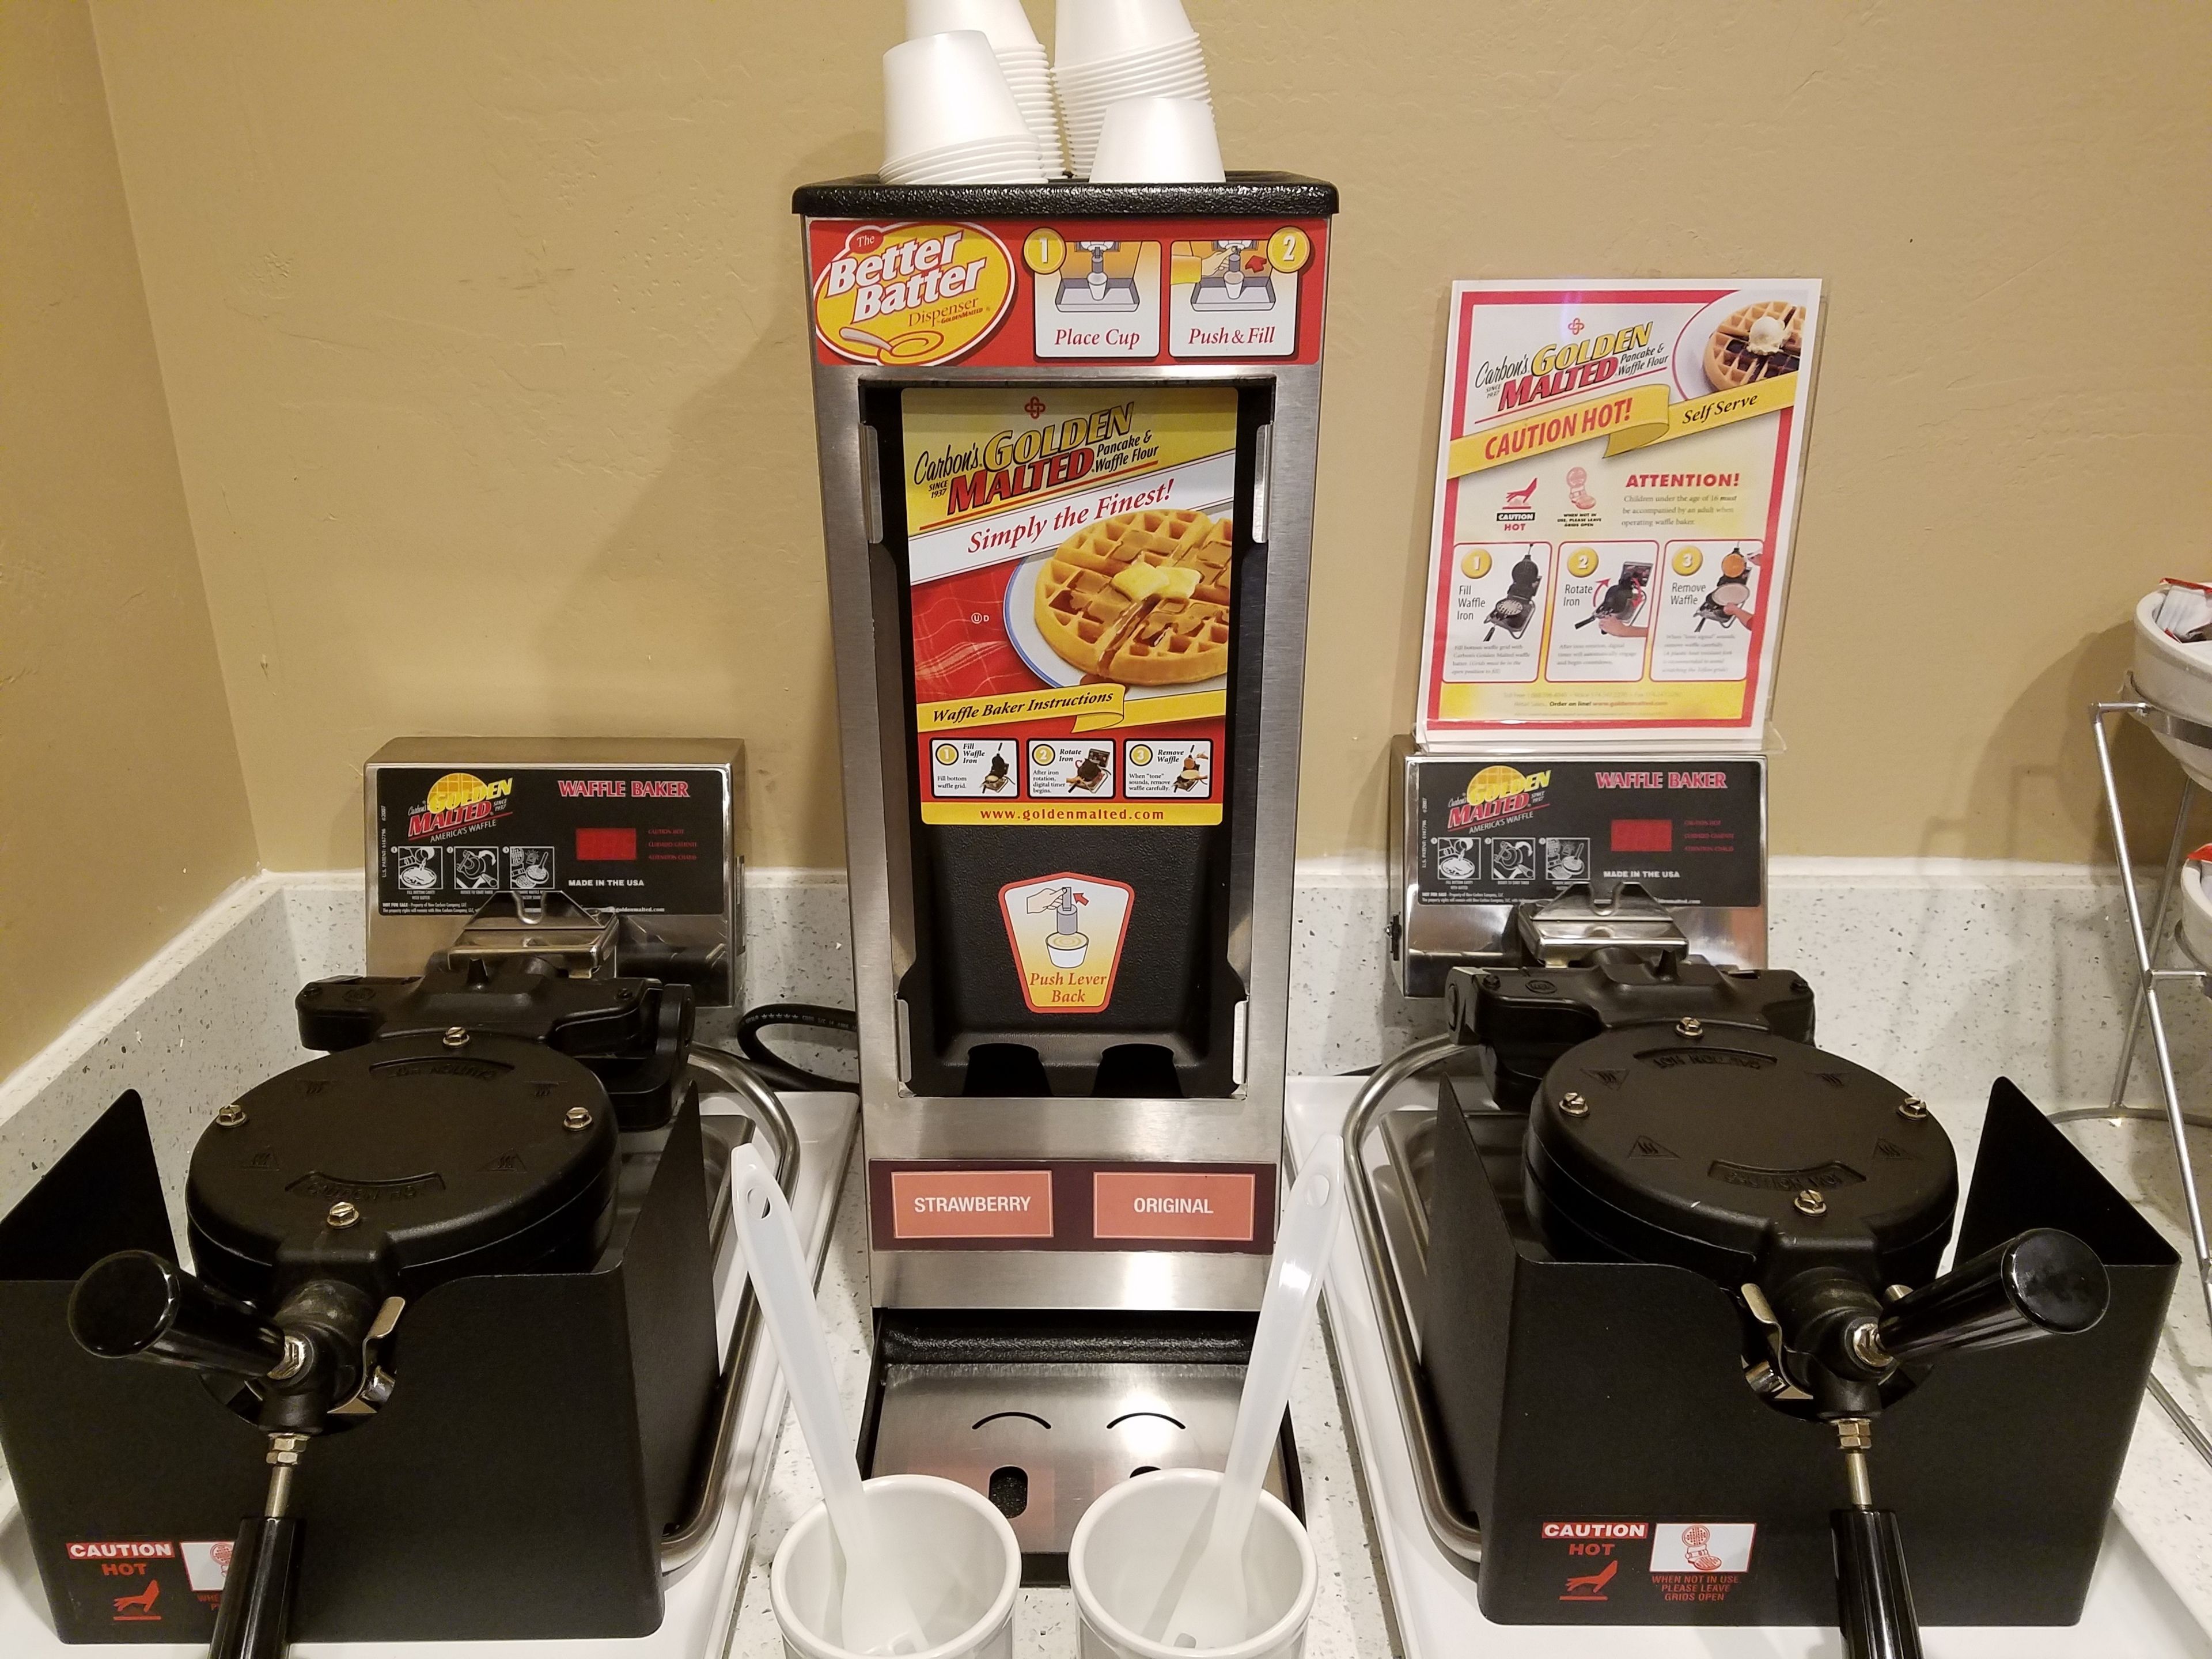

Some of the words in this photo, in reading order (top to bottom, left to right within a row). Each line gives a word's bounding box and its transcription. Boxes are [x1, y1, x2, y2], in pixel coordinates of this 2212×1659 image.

[857, 235, 875, 247] The
[1040, 238, 1048, 263] 1
[1283, 236, 1296, 261] 2
[825, 230, 964, 298] Better
[851, 257, 987, 324] Batter
[908, 297, 979, 327] Dispenser
[1055, 329, 1099, 346] Place
[1106, 328, 1140, 350] Cup
[1475, 354, 1528, 388] Carbon's
[1531, 321, 1653, 376] GOLDEN
[1620, 347, 1656, 364] Pancake
[1657, 343, 1664, 353] &
[1618, 361, 1645, 376] Waffle
[1647, 355, 1668, 368] Flour
[1498, 357, 1618, 411] MALTED
[1682, 402, 1715, 425] Self
[1714, 394, 1758, 416] Serve
[1484, 418, 1578, 460] CAUTION
[1582, 398, 1633, 434] HOT!
[914, 443, 979, 486] Carbon's
[983, 402, 1134, 472] GOLDEN
[1097, 435, 1141, 457] Pancake
[1143, 430, 1152, 444] &
[1095, 452, 1128, 473] Waffle
[1131, 444, 1160, 462] Flour
[928, 480, 949, 492] SINCE
[947, 447, 1094, 516] MALTED
[1626, 474, 1740, 487] ATTENTION!
[931, 488, 948, 499] 1937
[968, 519, 1048, 554] Simply
[1054, 506, 1089, 529] the
[1094, 478, 1175, 520] Finest!
[1677, 507, 1685, 515] by
[1473, 556, 1480, 570] 1
[1578, 555, 1589, 569] 2
[1683, 554, 1692, 567] 3
[1459, 585, 1472, 596] Fill
[1565, 584, 1593, 596] Rotate
[1672, 582, 1706, 593] Remove
[1457, 597, 1486, 609] Waffle
[1563, 596, 1580, 607] Iron
[1671, 594, 1698, 605] Waffle
[1457, 610, 1474, 620] Iron
[933, 705, 979, 724] Waffle
[982, 700, 1025, 717] Baker
[1027, 691, 1113, 712] Instructions
[945, 749, 949, 759] 1
[1040, 750, 1047, 760] 2
[1137, 750, 1144, 760] 3
[1595, 771, 1663, 789] WAFFLE
[1668, 771, 1728, 789] BAKER
[558, 781, 626, 797] WAFFLE
[631, 781, 690, 797] BAKER
[1467, 770, 1551, 806] GOLDEN
[429, 777, 513, 814] GOLDEN
[493, 798, 507, 806] SINCE
[980, 808, 1164, 822] www.goldenmalted.com
[1448, 793, 1530, 829] MALTED
[408, 801, 491, 837] MALTED
[1469, 818, 1505, 834] AMERICA'S
[1506, 811, 1533, 824] WAFFLE
[430, 827, 468, 843] AMERICA'S
[468, 819, 497, 832] WAFFLE
[1029, 972, 1063, 986] Push
[1068, 973, 1107, 986] Lever
[1051, 990, 1085, 1003] Back
[914, 1196, 1031, 1213] STRAWBERRY
[1134, 1198, 1214, 1214] ORIGINAL
[1544, 1525, 1645, 1537] CAUTION
[70, 1543, 172, 1557] CAUTION
[1569, 1544, 1615, 1555] HOT
[102, 1563, 147, 1575] HOT
[1652, 1575, 1681, 1584] WHEN
[1684, 1575, 1703, 1584] NOT
[1707, 1575, 1717, 1584] IN
[1700, 1584, 1731, 1592] LEAVE
[1665, 1593, 1694, 1601] GRIDS
